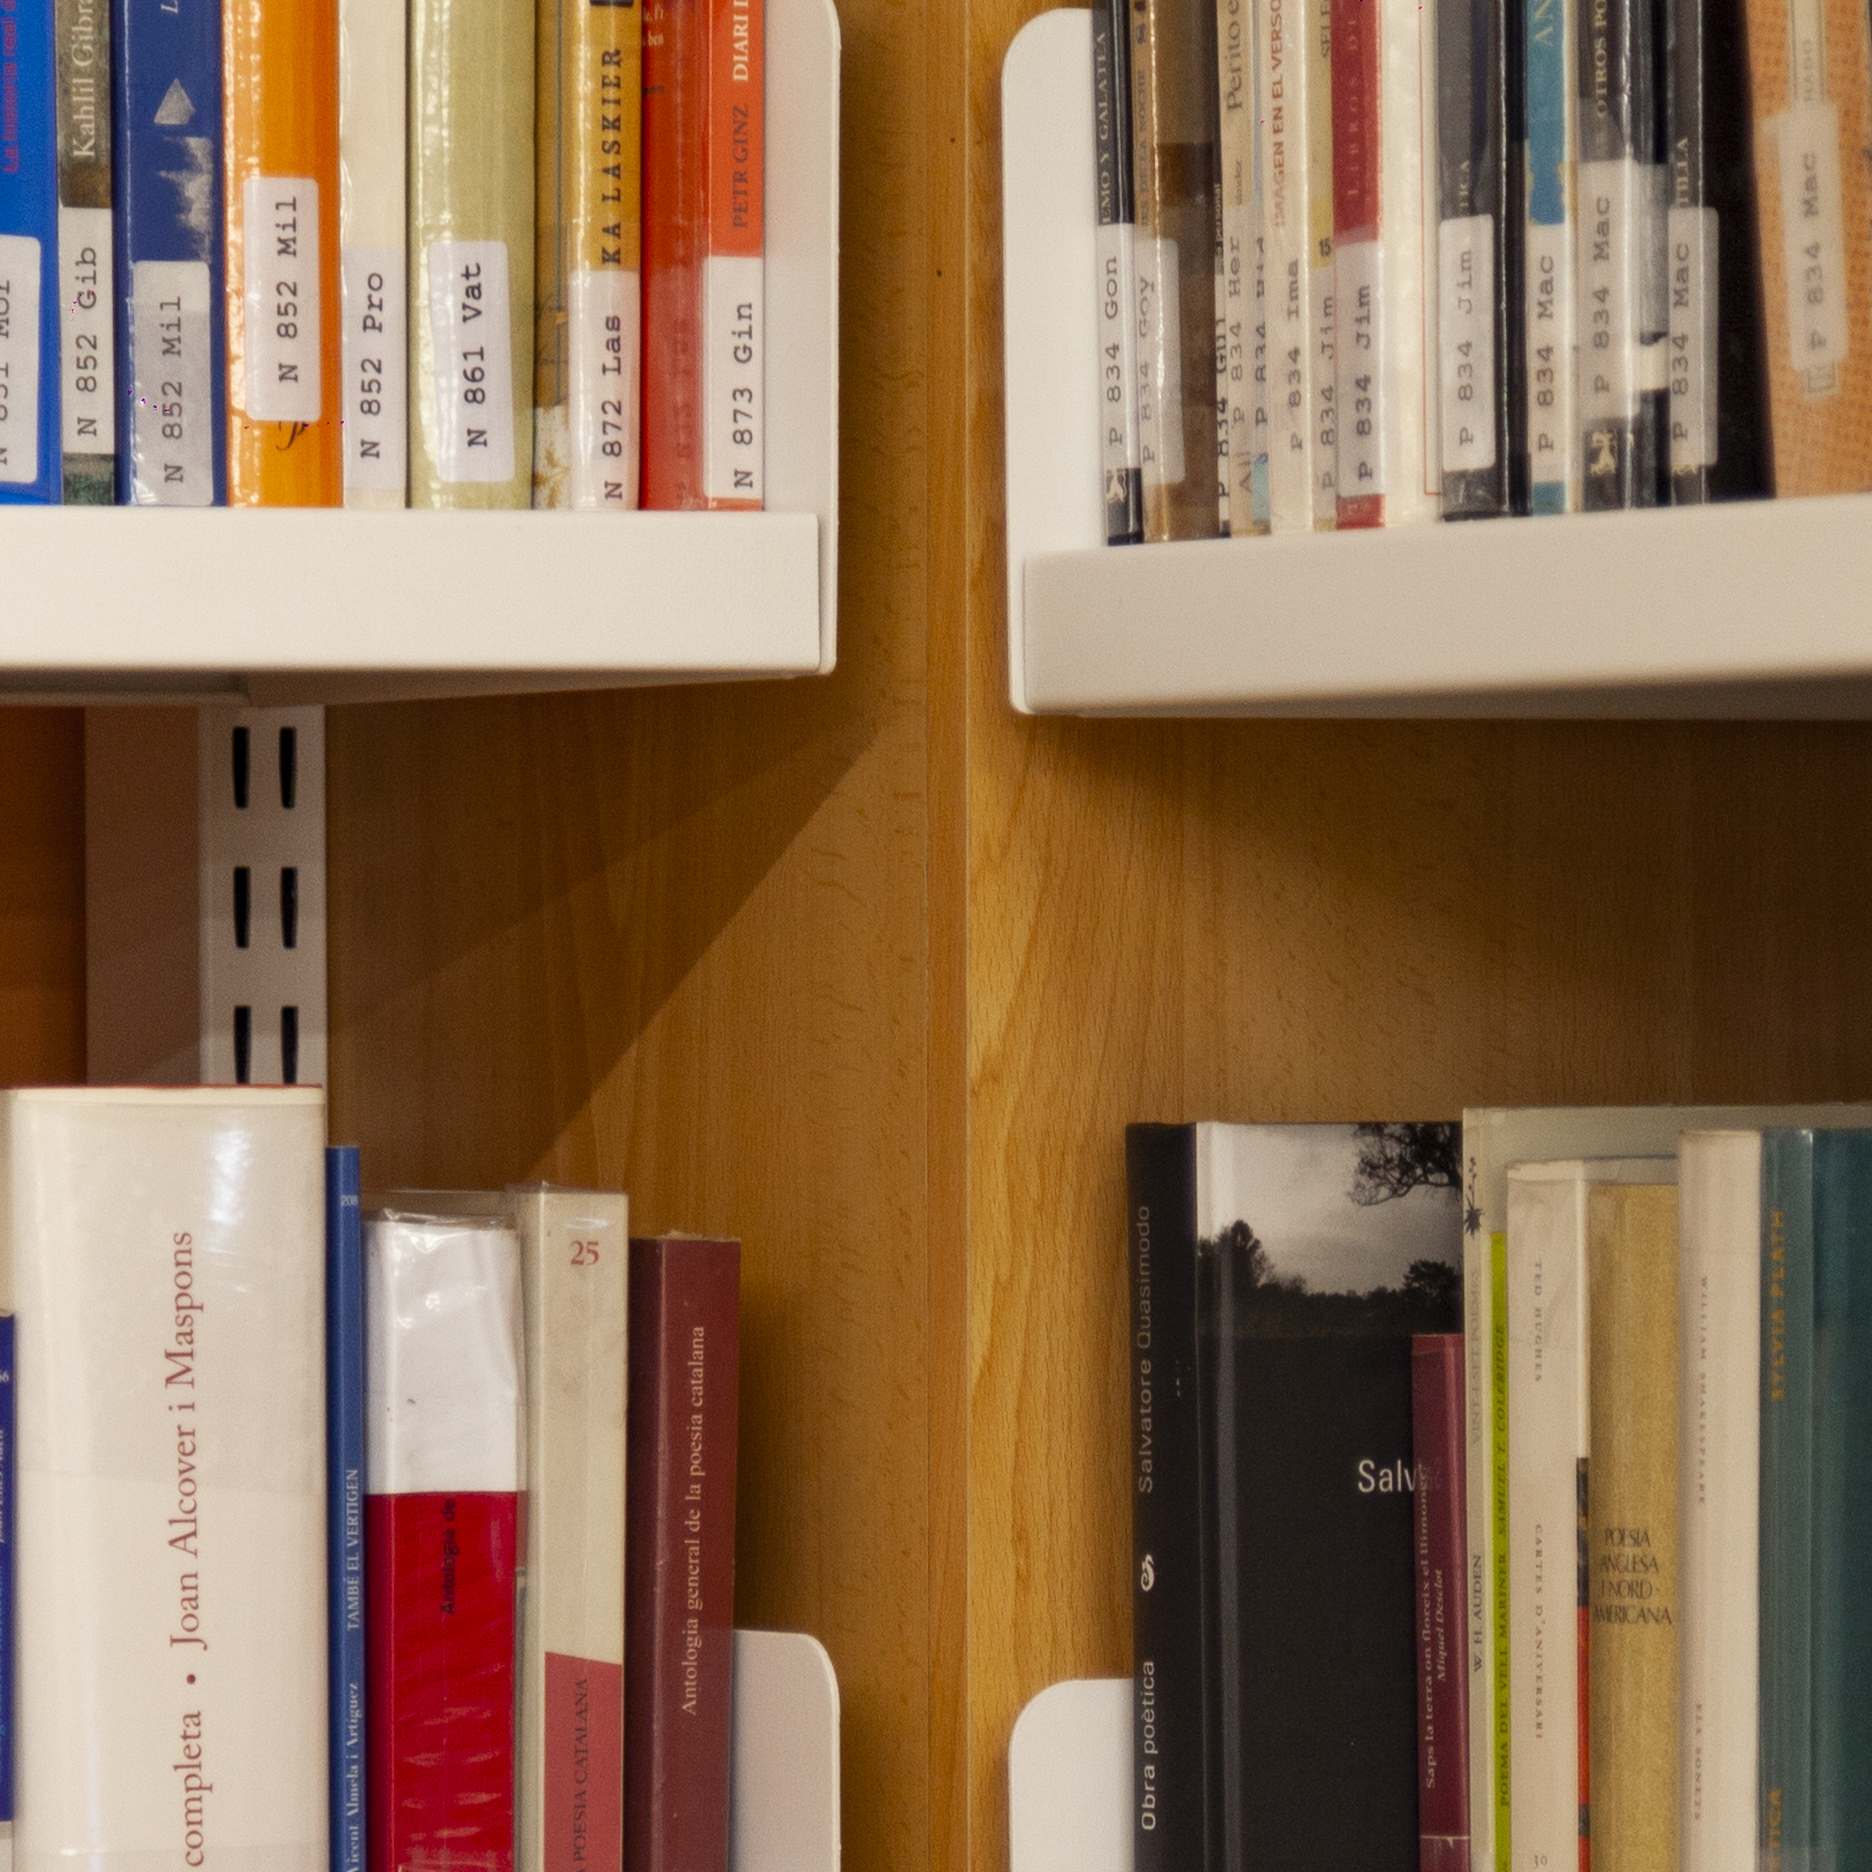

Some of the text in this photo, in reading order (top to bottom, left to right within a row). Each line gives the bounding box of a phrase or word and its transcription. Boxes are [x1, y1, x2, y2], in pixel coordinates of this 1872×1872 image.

[73, 78, 95, 158] Kahlil
[733, 104, 748, 228] PETR GINZ
[75, 247, 97, 436] N 852 Gib
[277, 196, 298, 382] N 852 Mil
[1104, 256, 1122, 445] P 834 Gon
[1536, 255, 1554, 452] P 834 Mac
[1593, 196, 1609, 393] P 834 Mac
[602, 316, 622, 500] N 872 Las
[733, 303, 753, 488] N 873 Gin
[1354, 284, 1372, 480] P 834 Jim
[164, 1230, 205, 1390] Maspons
[570, 1240, 599, 1265] 25
[1135, 1205, 1153, 1492] Salvatore Quasimodo
[167, 1424, 200, 1559] Alcover
[680, 1326, 706, 1715] Antologia general de la poesia catalana
[169, 1571, 207, 1650] Joan
[174, 1710, 213, 1867] completa
[1139, 1662, 1159, 1830] Obra poètica
